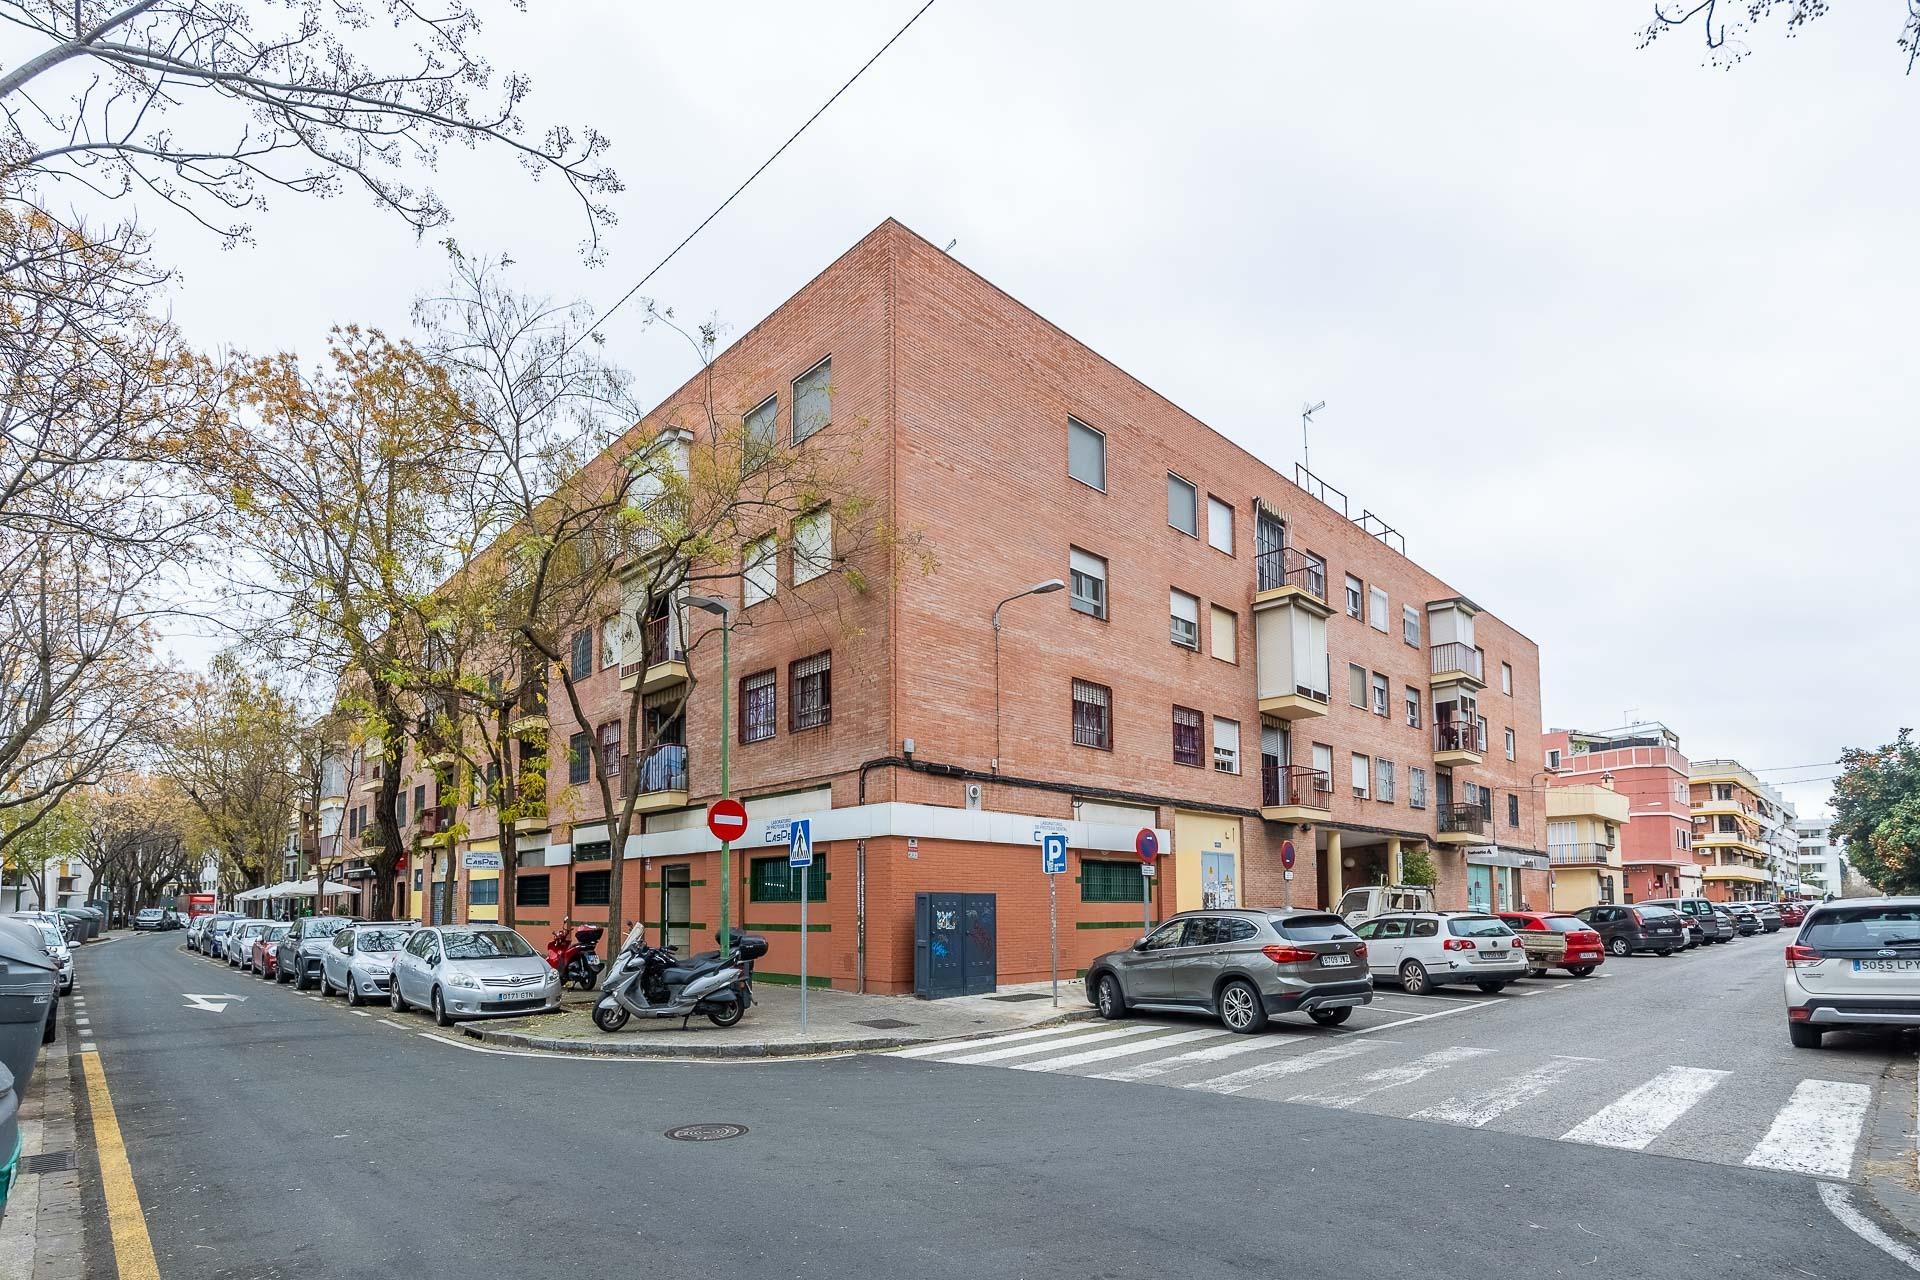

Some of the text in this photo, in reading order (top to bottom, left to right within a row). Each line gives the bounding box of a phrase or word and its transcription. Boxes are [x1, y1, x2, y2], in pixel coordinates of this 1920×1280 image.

[1049, 840, 1061, 861] P
[1862, 960, 1920, 970] 5055 LPY
